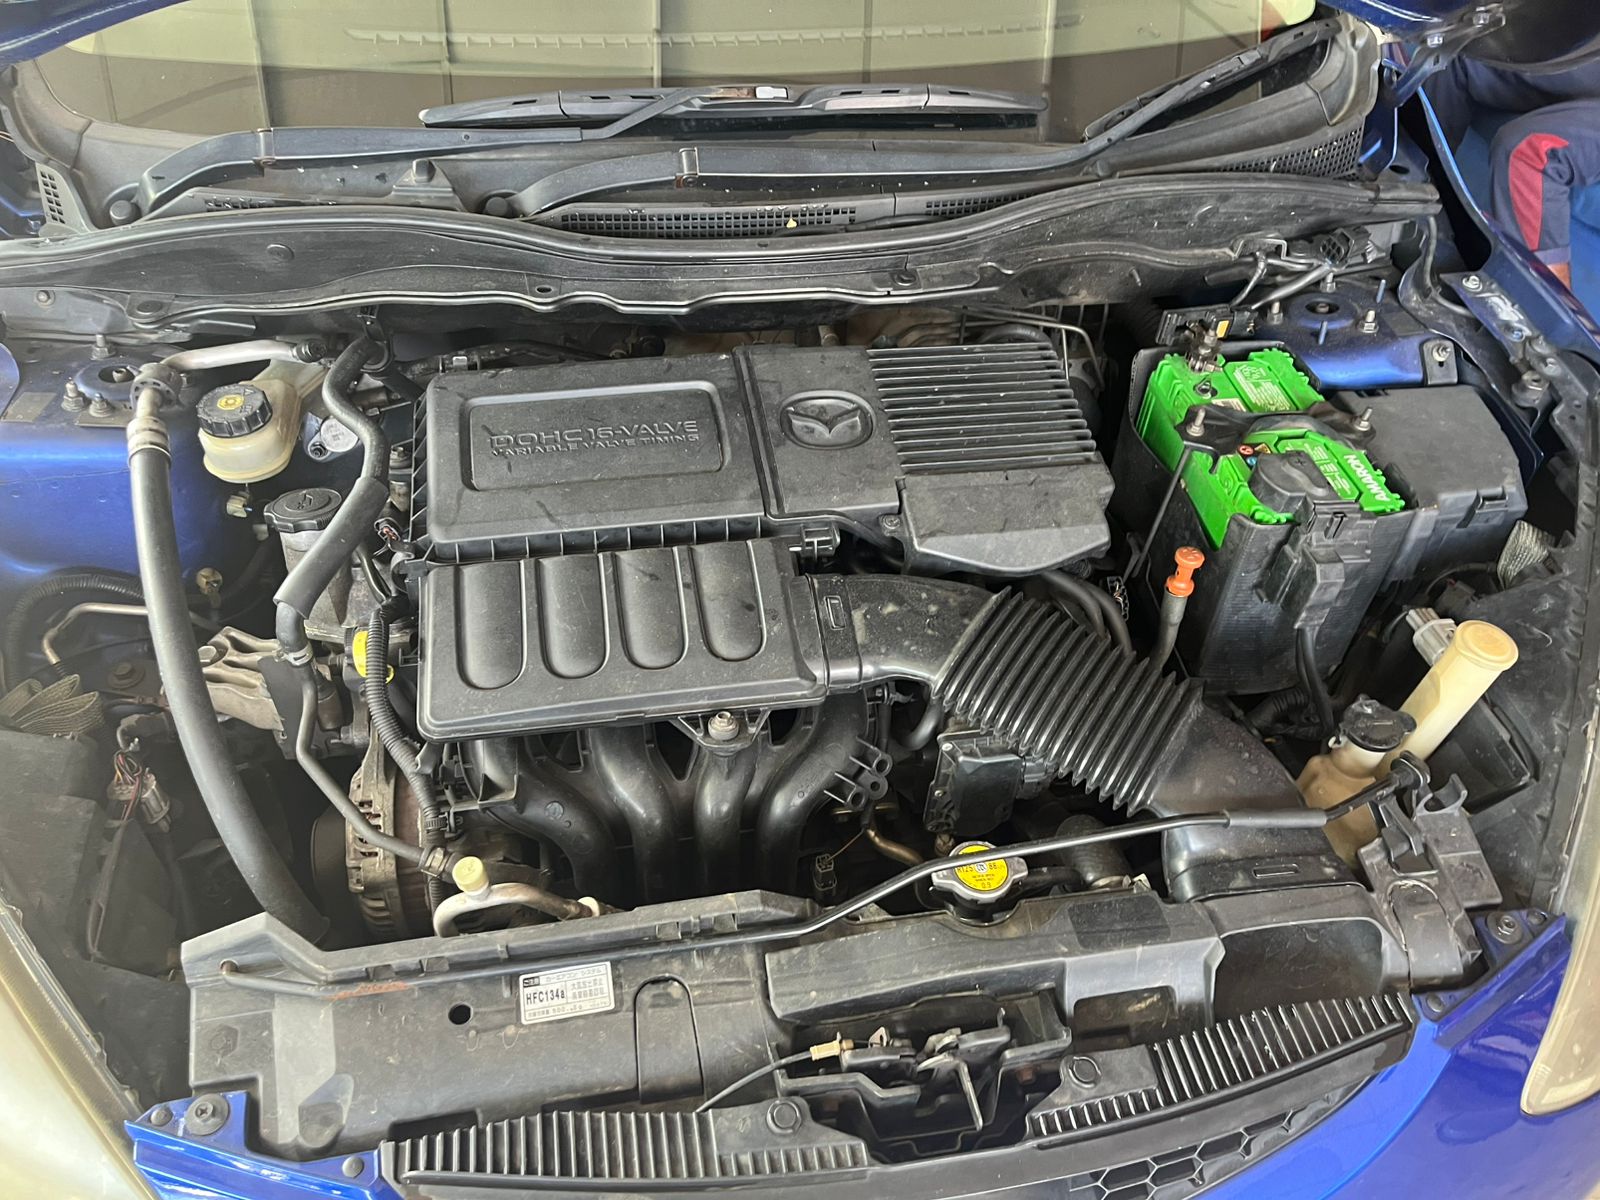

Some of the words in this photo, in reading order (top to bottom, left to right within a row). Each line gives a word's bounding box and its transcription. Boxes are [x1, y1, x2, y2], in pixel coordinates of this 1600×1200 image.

[488, 428, 583, 448] DOHC
[587, 420, 699, 440] 16-VALVE
[491, 442, 579, 456] VARIABLE
[583, 438, 636, 449] VALVE
[639, 433, 700, 444] TIMING
[1343, 454, 1391, 502] AMARON
[525, 988, 565, 1006] HFC134a
